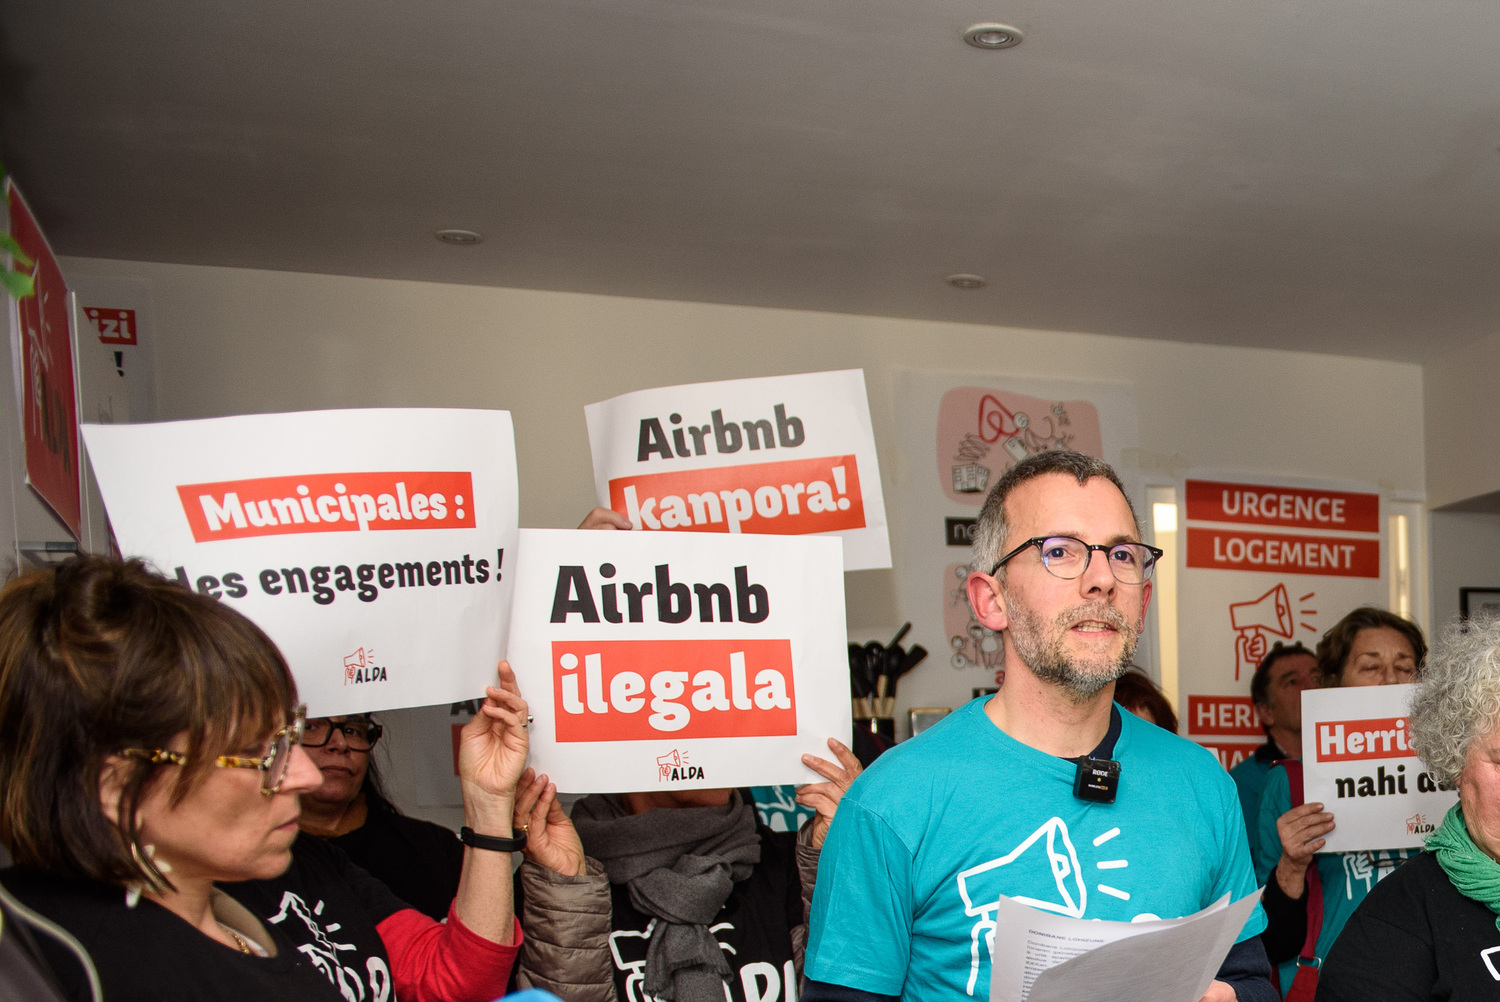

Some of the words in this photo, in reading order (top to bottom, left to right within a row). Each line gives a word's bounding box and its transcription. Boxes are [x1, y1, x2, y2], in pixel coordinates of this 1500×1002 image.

[636, 403, 806, 463] Airbnb
[199, 482, 448, 532] Municipales
[455, 495, 466, 520] :
[624, 465, 851, 534] kanpora!
[1221, 490, 1346, 523] URGENCE
[1212, 535, 1356, 569] LOGEMENT
[258, 554, 490, 605] engagements
[549, 562, 771, 625] Airbnb
[354, 666, 388, 684] ALDA
[559, 651, 792, 733] ilegala
[670, 765, 706, 781] ALDA
[1335, 764, 1408, 799] nahi
